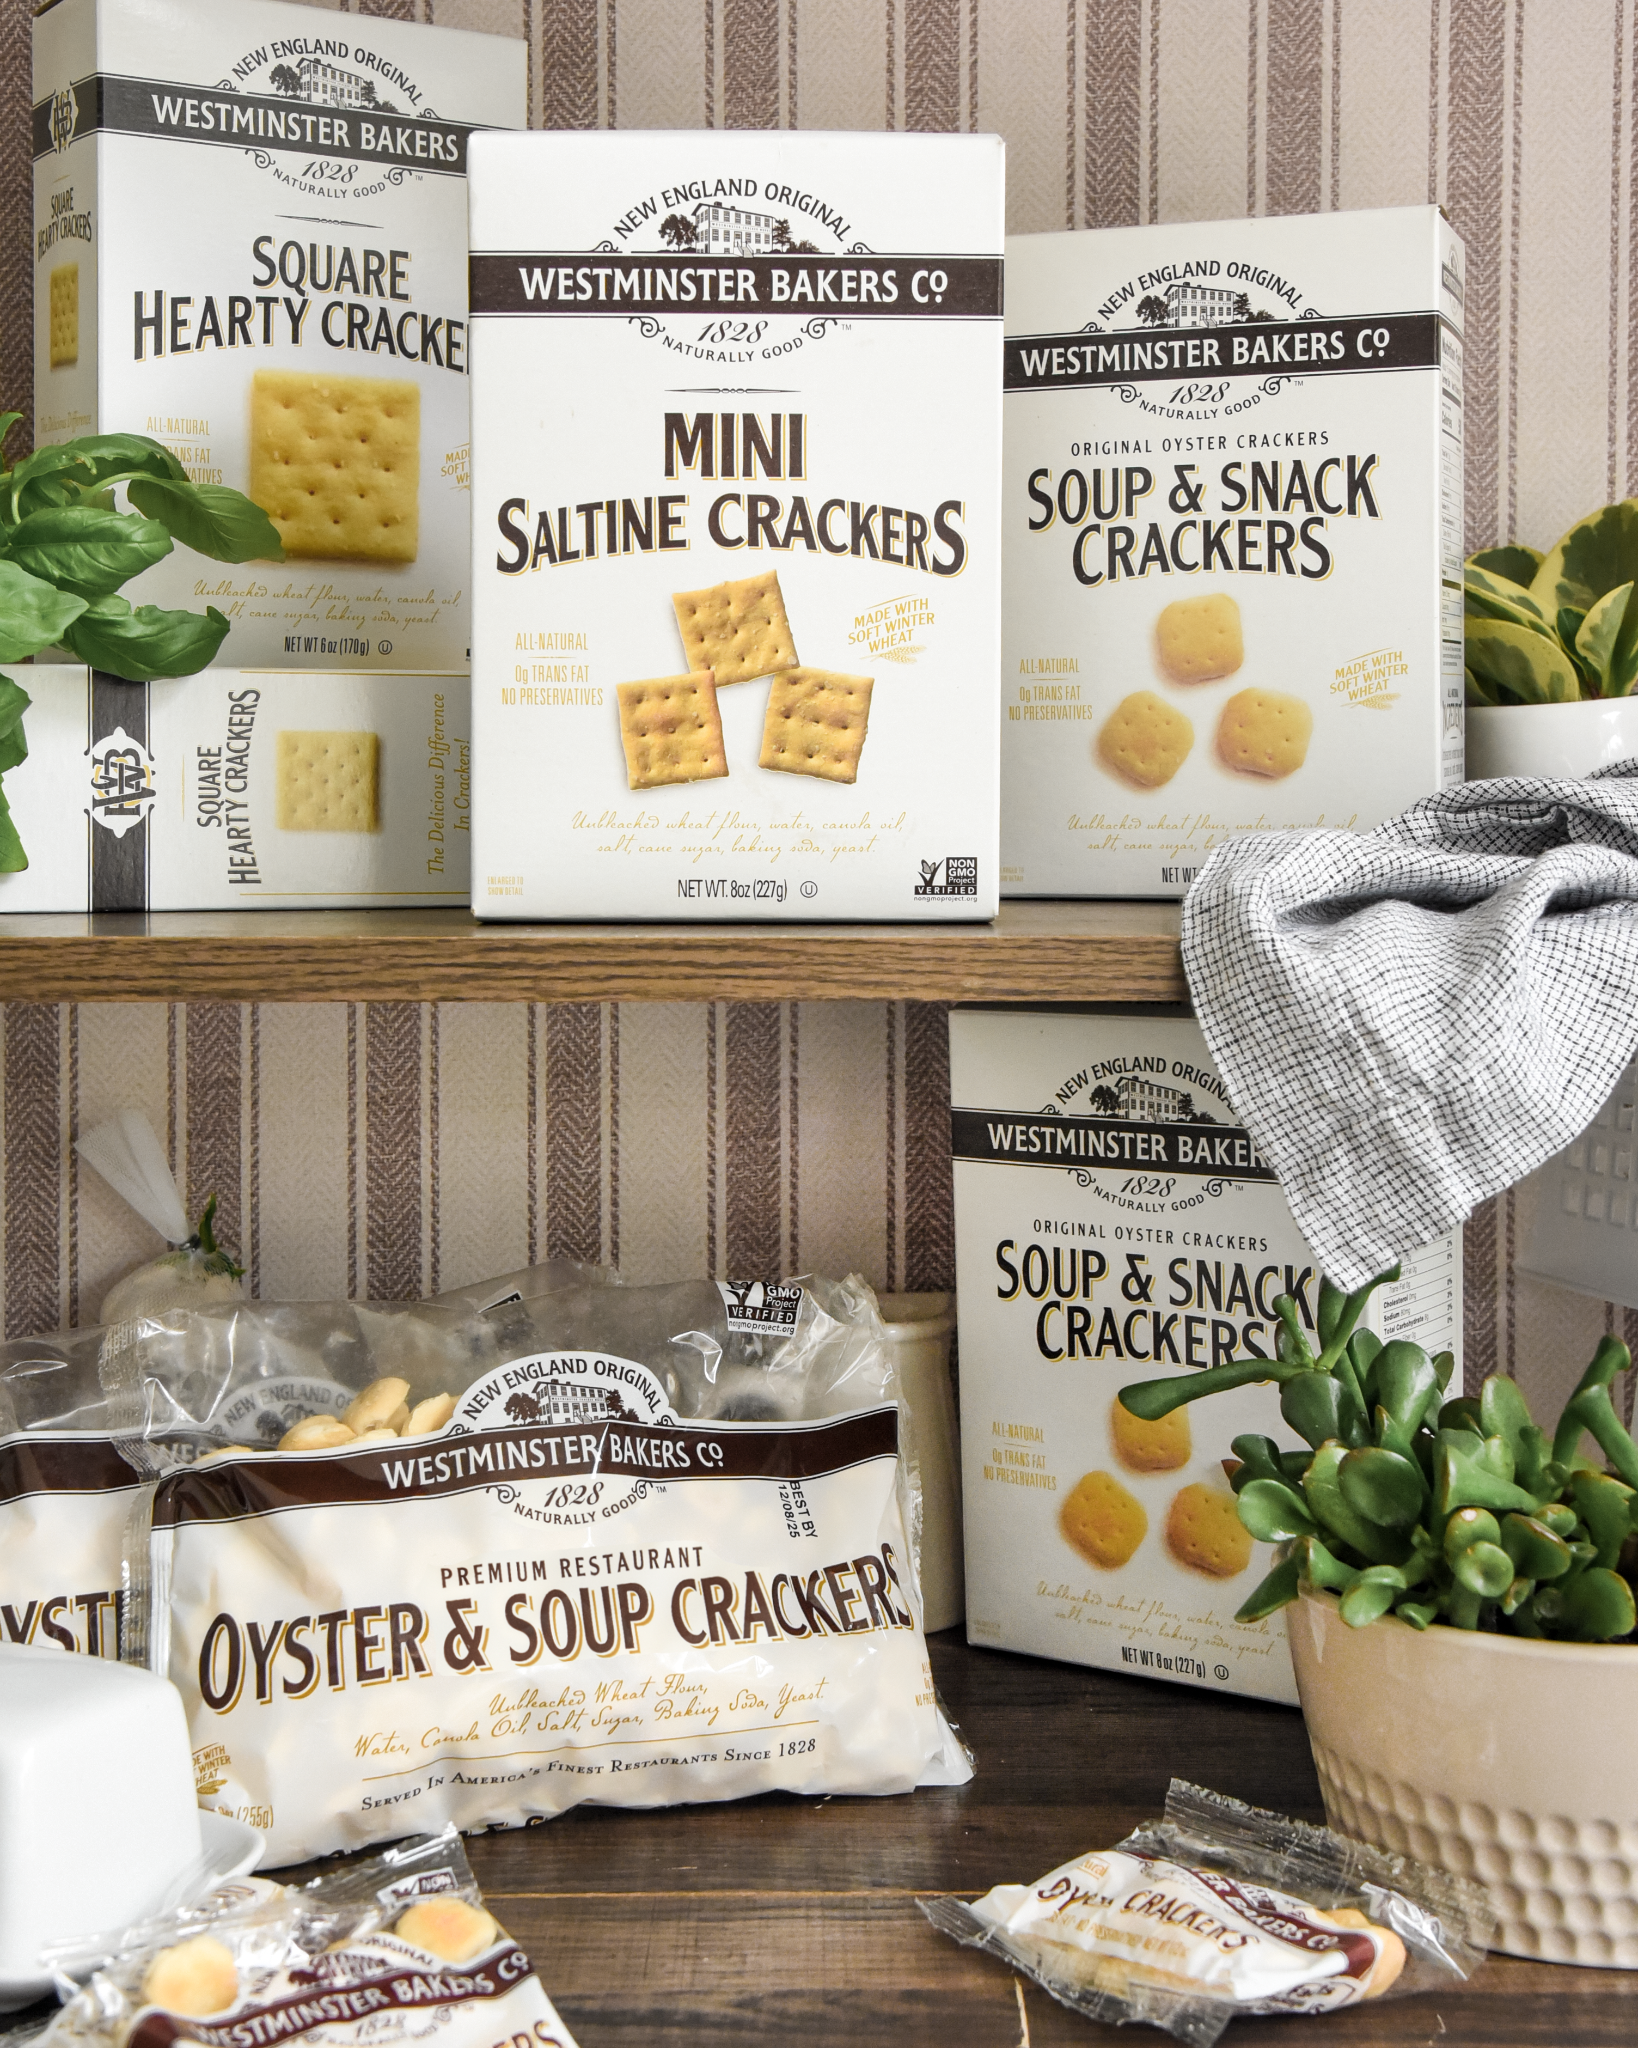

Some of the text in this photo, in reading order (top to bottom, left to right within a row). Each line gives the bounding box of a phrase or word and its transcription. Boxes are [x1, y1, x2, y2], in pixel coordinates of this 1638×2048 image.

[231, 38, 424, 106] NEW ENGLAND ORIGINAL
[151, 94, 459, 162] WESTMINSTER BAKERS
[272, 167, 386, 199] NATURALLY GOOD
[301, 160, 359, 184] 1828
[613, 178, 852, 242] NEW ENGLAND ORIGINAL
[252, 235, 412, 303] SQUARE
[519, 267, 898, 303] WESTMINSTER BAKERS
[1097, 260, 1304, 321] NEW ENGLAND ORIGINAL
[133, 288, 310, 363] HEARTY
[697, 320, 769, 343] 1828
[662, 335, 803, 362] NATURALLY GOOD
[1020, 331, 1346, 378] WESTMINSTER BAKERS
[1168, 381, 1231, 405] 1828
[1139, 394, 1261, 421] NATURALLY GOOD
[146, 416, 210, 436] ALL-NATURAL
[194, 447, 211, 464] FAT
[664, 412, 807, 480] MINI
[1071, 430, 1330, 457] ORIGINAL OYSTER CRACKERS
[440, 460, 466, 477] SOFT
[1027, 466, 1155, 533] SOUP
[1168, 463, 1207, 516] &
[1220, 454, 1383, 521] SNACK
[496, 492, 968, 577] SALTINE CRACKERS
[1072, 515, 1335, 588] CRACKERS
[194, 579, 316, 601] Unbleached wheat
[854, 598, 928, 629] MADE WITH
[515, 632, 588, 650] ALL-NATURAL
[848, 612, 935, 645] SOFT WINTER
[868, 628, 914, 653] WHEAT
[284, 636, 319, 653] NET WT
[532, 665, 589, 682] TRANS FAT
[1019, 658, 1080, 674] ALL-NATURAL
[1335, 650, 1403, 680] MADE WITH
[1329, 663, 1409, 695] SOFT WINTER
[1348, 678, 1389, 701] WHEAT
[502, 687, 603, 705] NO PRESERVATIVES
[1033, 685, 1081, 701] TRANS FAT
[1008, 704, 1093, 721] NO PRESERVATIVES
[197, 745, 222, 828] SQUARE
[224, 688, 262, 884] HEARTY CRACKERS
[428, 693, 451, 874] The Delicious Difference
[453, 738, 471, 832] In Crackers!
[572, 810, 871, 830] Unbleached wheat canola
[1067, 814, 1192, 831] Unbleached wheat
[639, 834, 782, 863] cane baking
[1123, 842, 1153, 851] cane
[948, 868, 976, 877] GMO
[949, 859, 975, 868] NON
[1161, 867, 1180, 883] NET
[677, 879, 788, 902] NET WT. 8oz (227g)
[917, 886, 975, 894] VERIFIED
[948, 877, 975, 885] Project
[1055, 1056, 1167, 1105] NEW ENGLAND
[987, 1122, 1169, 1167] WESTMINSTER
[1093, 1185, 1205, 1213] NATURALLY GOOD
[1120, 1175, 1177, 1198] 1828
[1033, 1218, 1268, 1252] ORIGINAL OYSTER CRACKERS
[767, 1286, 800, 1299] GMO
[996, 1239, 1318, 1332] SOUP & SNACK
[732, 1306, 794, 1323] VERIFIED
[766, 1296, 797, 1308] Project
[1383, 1311, 1400, 1323] Sodium
[1383, 1326, 1396, 1336] Total
[462, 1358, 662, 1421] NEW ENGLAND ORIGINAL
[381, 1433, 691, 1490] WESTMINSTER BAKERS
[544, 1481, 604, 1508] 1828
[514, 1492, 637, 1526] NATURALLY GOOD
[778, 1484, 800, 1538] 12/08/25
[790, 1481, 819, 1538] BEST BY
[440, 1546, 704, 1589] PREMIUM RESTAURANT
[199, 1542, 915, 1716] OYSTER & SOUP CRACKERS
[1121, 1646, 1154, 1667] NET WT
[489, 1676, 656, 1716] Unbleached Wheat
[354, 1689, 769, 1758] Water, Canola Salt, Sugar, Baking Soda,
[198, 1755, 232, 1774] WINTER
[203, 1745, 226, 1760] WITH
[361, 1738, 817, 1811] SERVED AMERICA'S FINEST RESTAURANTS SINCE 1828
[391, 1972, 495, 2002] BAKERS
